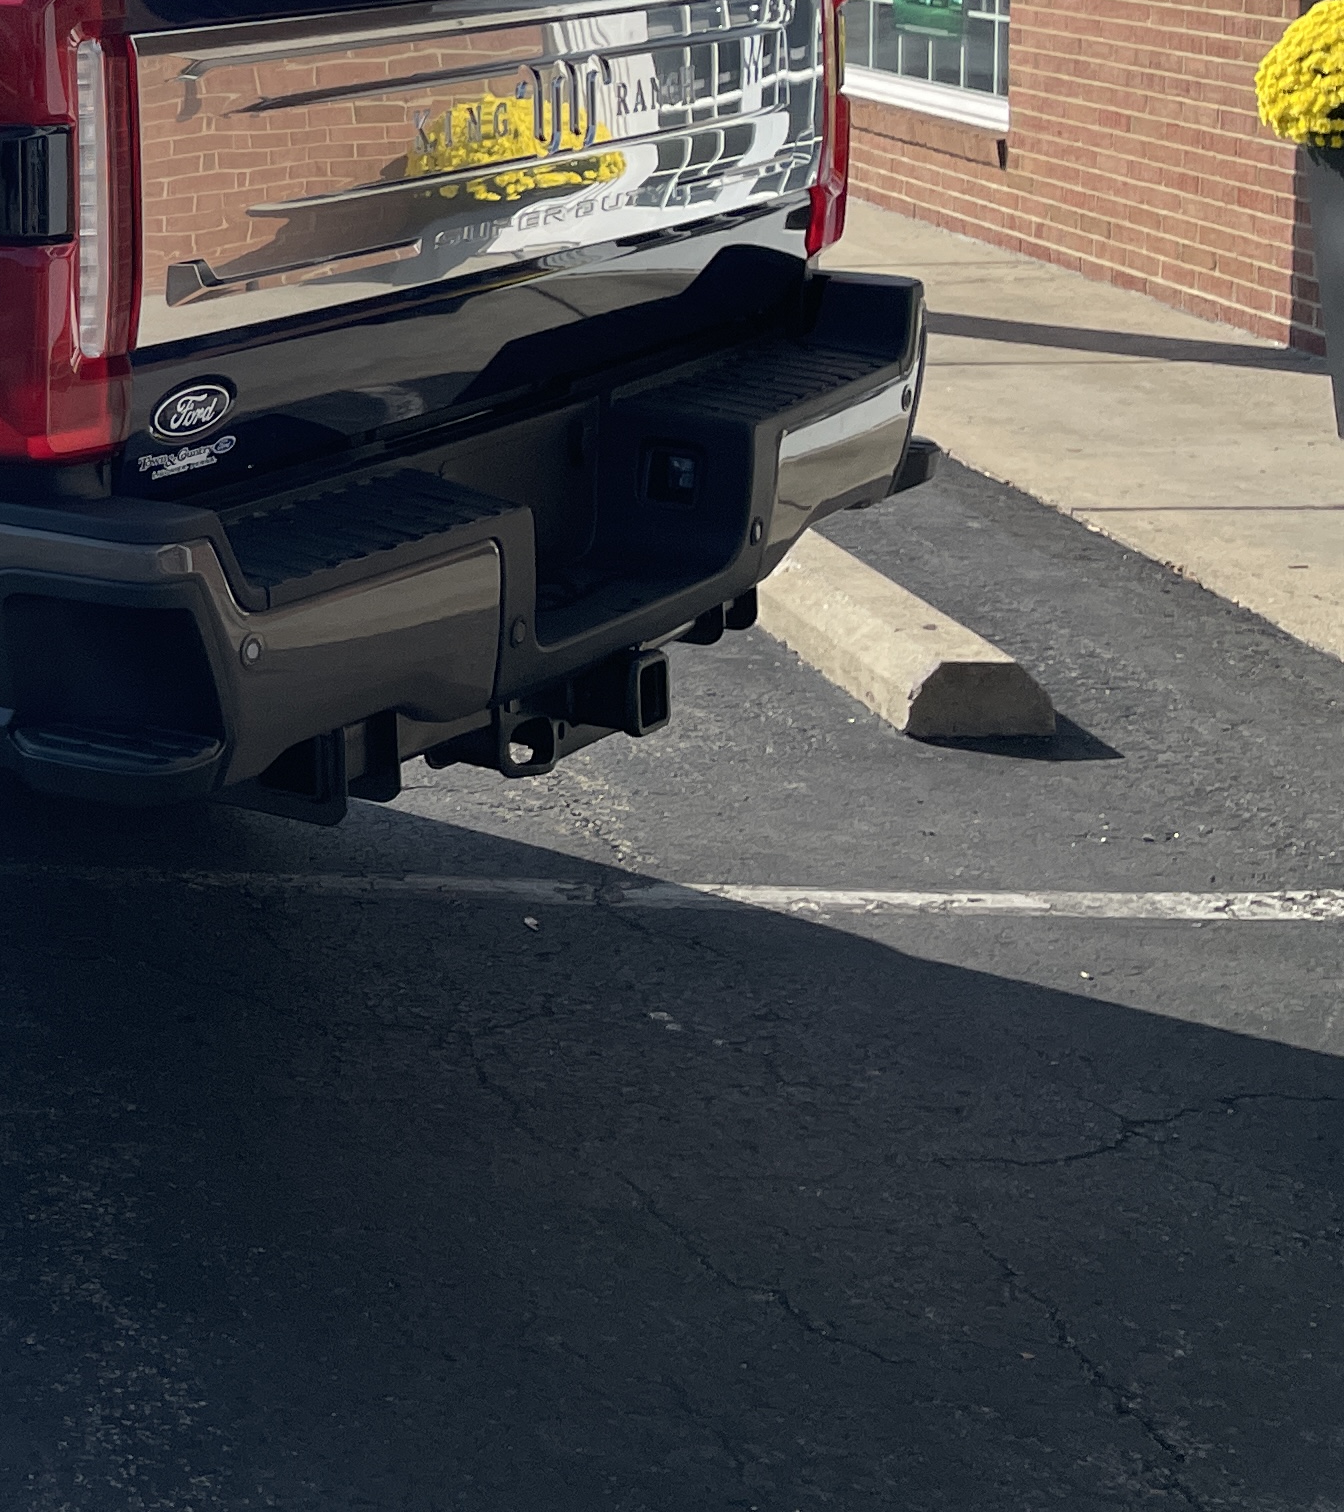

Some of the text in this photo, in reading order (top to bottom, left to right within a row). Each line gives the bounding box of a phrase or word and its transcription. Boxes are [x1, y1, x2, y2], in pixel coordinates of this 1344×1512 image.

[413, 64, 696, 154] KING RANCH
[433, 205, 566, 251] SUPER
[169, 392, 219, 430] Ford
